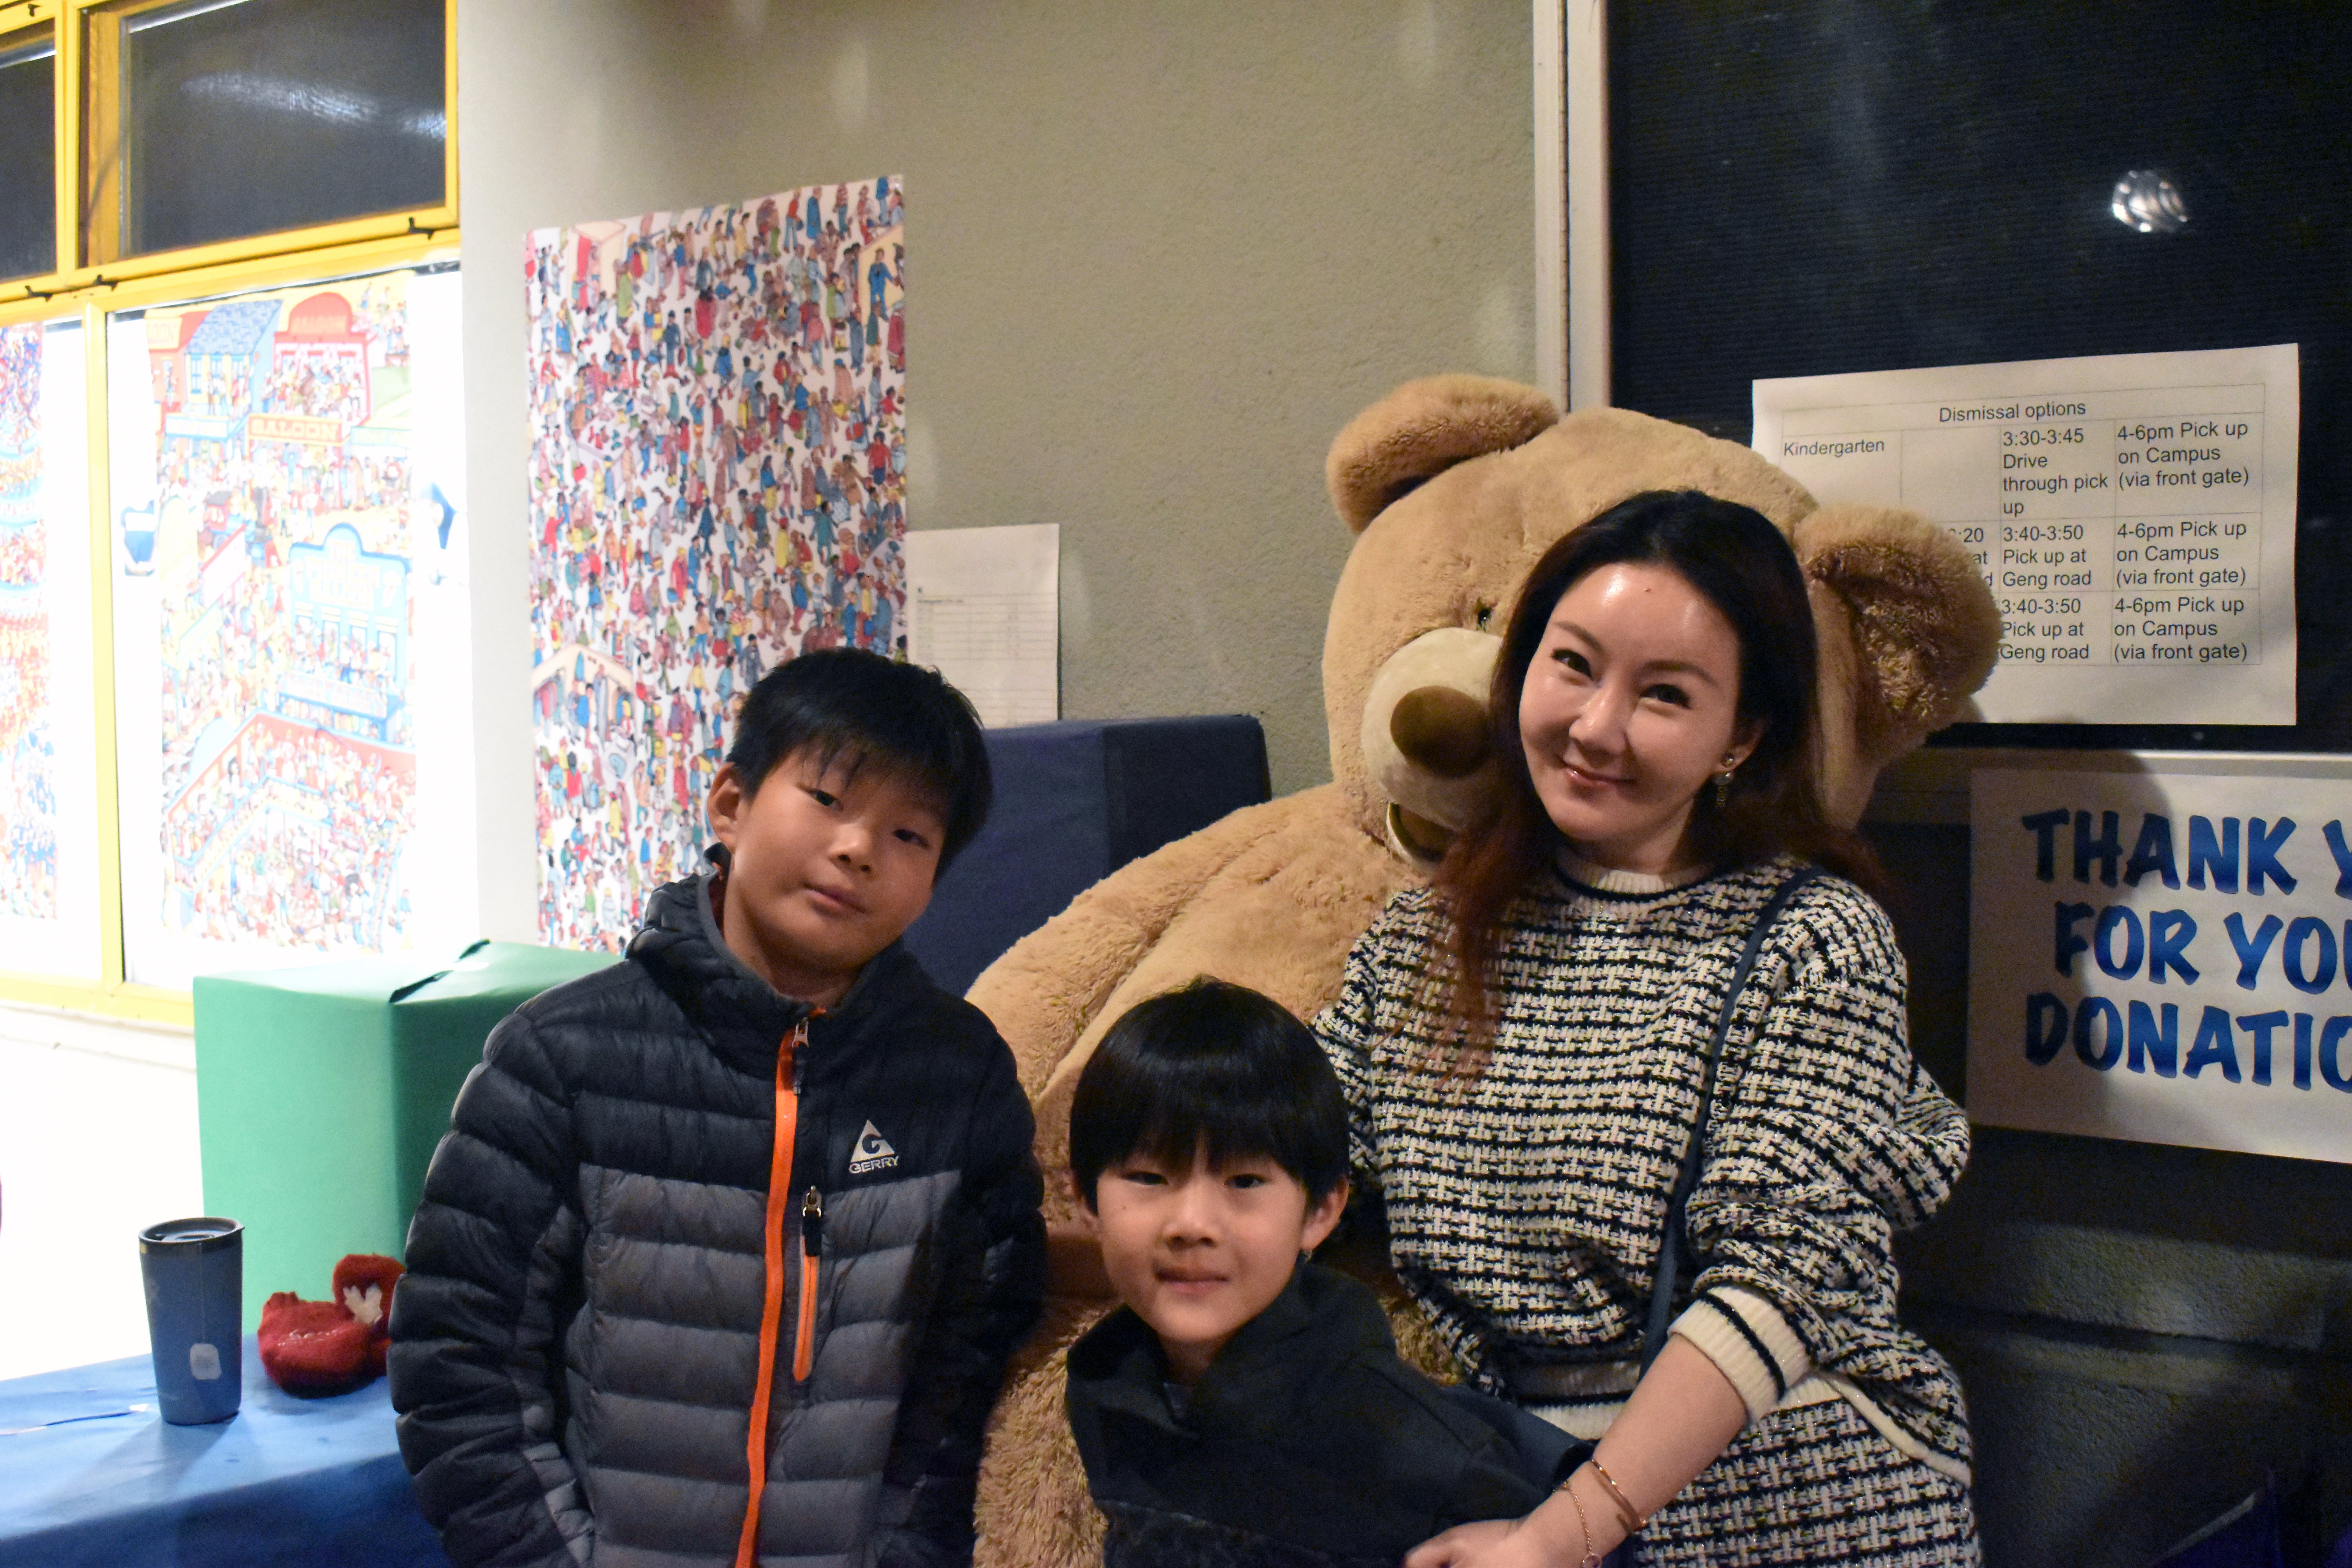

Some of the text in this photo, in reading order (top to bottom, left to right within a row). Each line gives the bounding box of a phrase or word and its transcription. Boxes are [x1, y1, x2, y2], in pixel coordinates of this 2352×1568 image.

[1940, 403, 2086, 422] Dismissal options
[251, 418, 338, 440] SALOON
[2004, 428, 2084, 446] 3:30-3:45
[2118, 421, 2248, 443] 4-6pm Pick up
[1784, 440, 1884, 457] Kindergarten
[2118, 447, 2221, 465] on Campus
[2004, 454, 2047, 469] Drive
[2003, 474, 2107, 494] through pick
[2119, 468, 2249, 490] (via front gate)
[2004, 503, 2024, 517] up
[2004, 524, 2083, 542] 3:40-3:50
[2117, 521, 2247, 541] 4-6pm Pick up
[2004, 549, 2086, 566] Pick up at
[2117, 545, 2219, 564] on Campus
[2003, 571, 2047, 590] Geng
[2054, 570, 2091, 586] road
[2116, 568, 2246, 587] (via front gate)
[2002, 598, 2081, 614] 3:40-3:50
[2115, 597, 2244, 616] 4-6pm Pick up
[2003, 622, 2083, 639] Pick up at
[2114, 620, 2218, 639] on Campus
[2000, 644, 2089, 663] Geng road
[2114, 643, 2247, 663] (via front gate)
[2022, 808, 2298, 896] THANK
[2054, 901, 2352, 994] FOR YO
[2025, 992, 2352, 1093] DONATIO
[848, 1155, 899, 1174] GERRY
